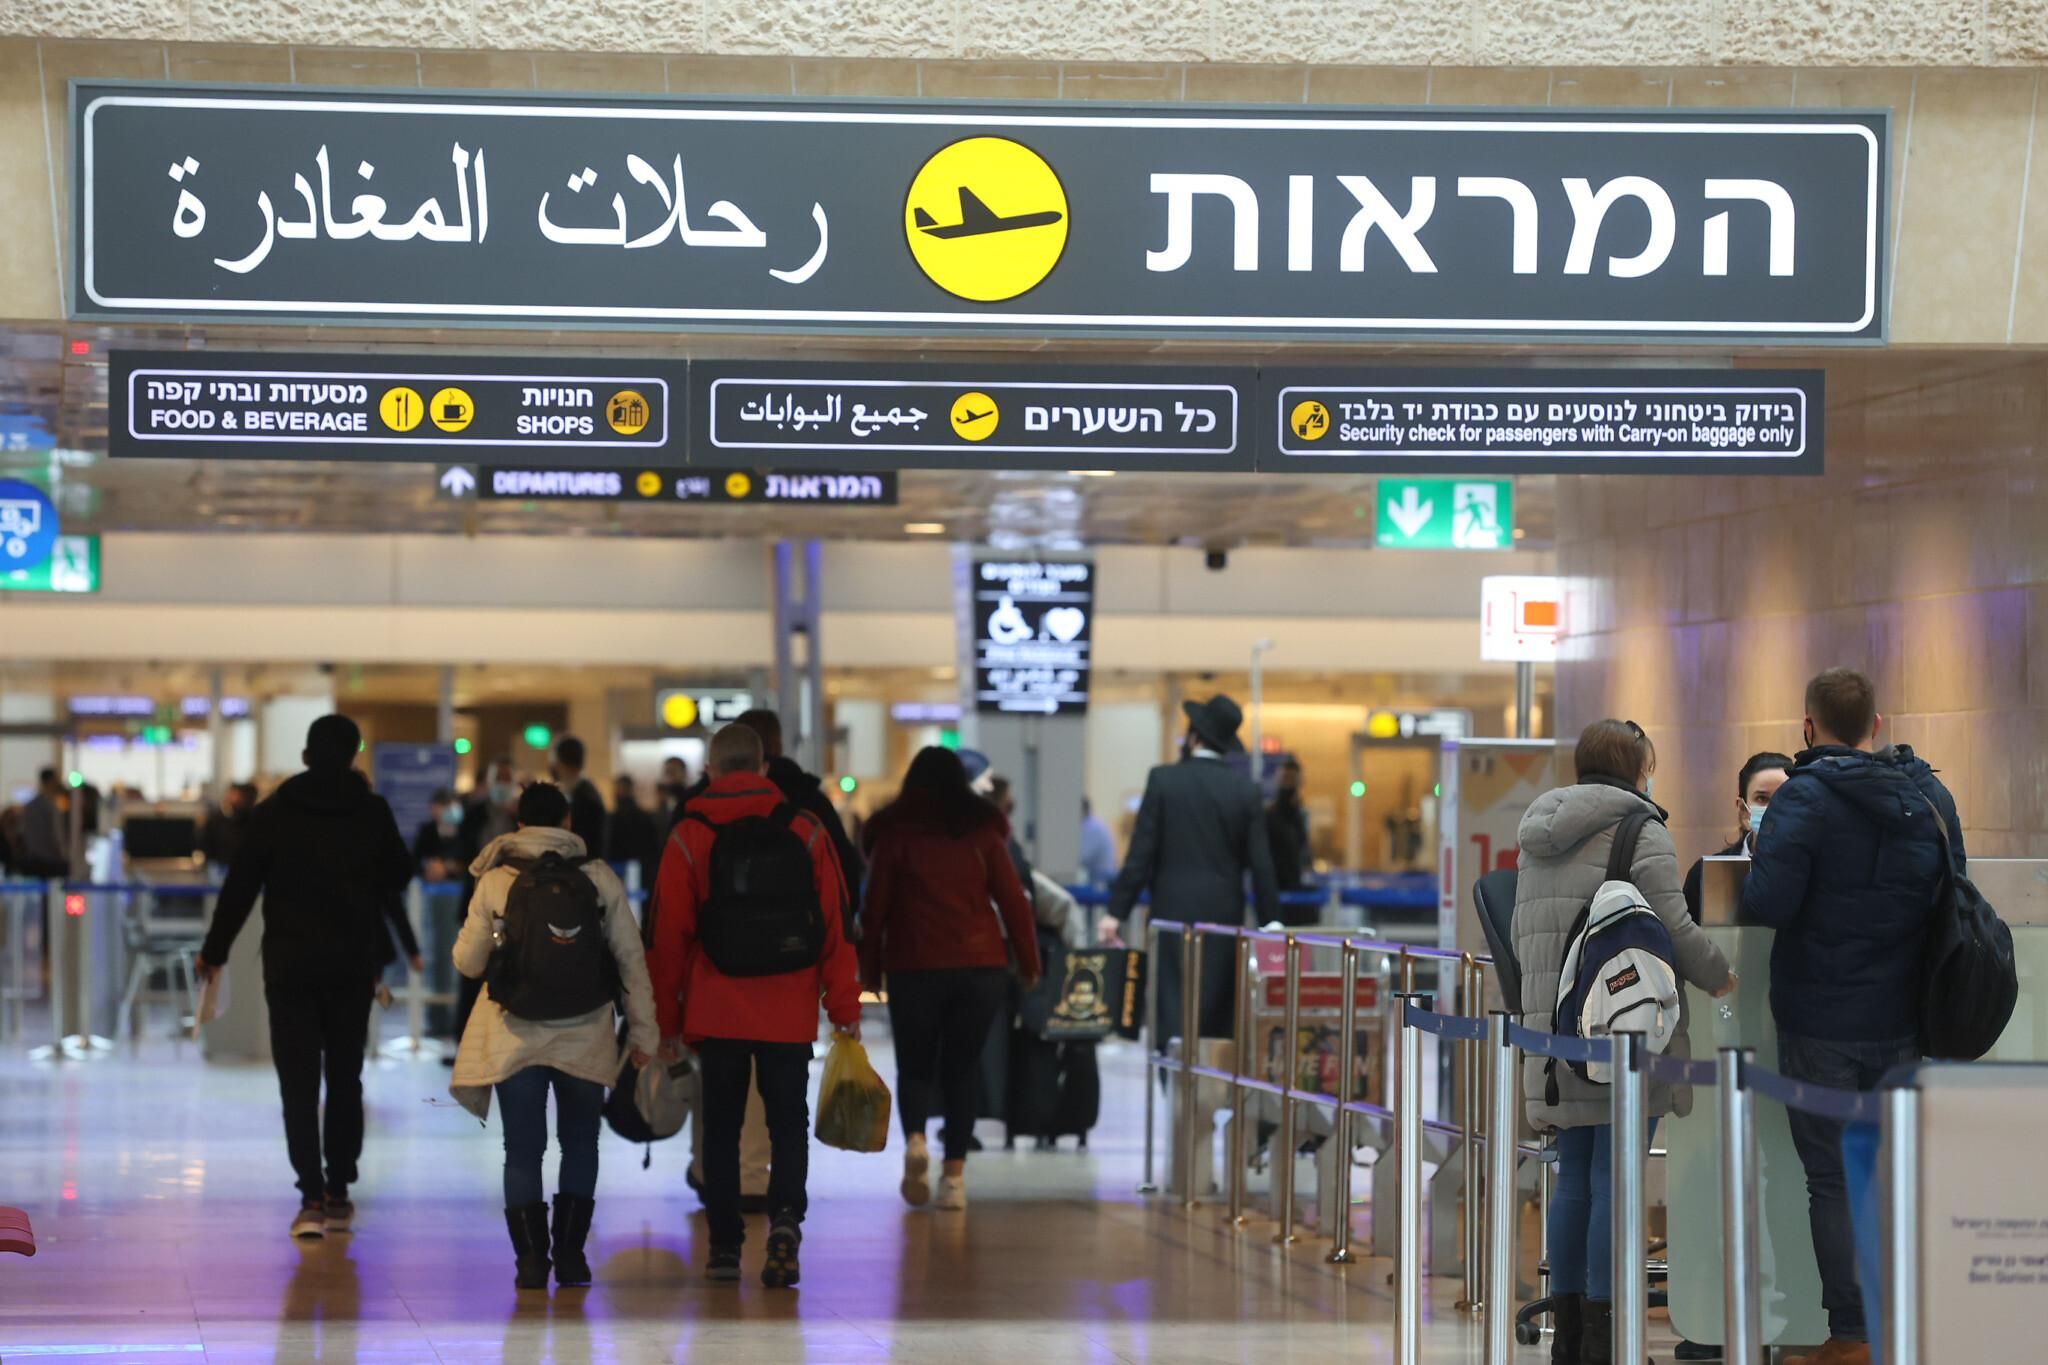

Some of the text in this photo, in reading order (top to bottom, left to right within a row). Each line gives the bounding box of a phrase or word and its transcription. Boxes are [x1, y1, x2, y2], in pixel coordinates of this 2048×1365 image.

[167, 141, 828, 284] رحلات المغادرة
[1146, 173, 1796, 278] המראות
[147, 381, 368, 405] מסעדות ובתי קפה
[521, 387, 594, 407] חנויות
[151, 409, 368, 431] FOOD & BEVERAGE
[740, 392, 929, 437] جميع البوابات
[1024, 401, 1217, 435] כל השערים
[1339, 399, 1795, 425] בידוק ביטחוני לנוסעים עם כבודת יד בלבד
[516, 415, 594, 435] SHOPS
[1339, 423, 1795, 447] Security check for passengers with Carry-on baggage only
[493, 471, 621, 495] DEPARTURES
[765, 475, 882, 499] המראות
